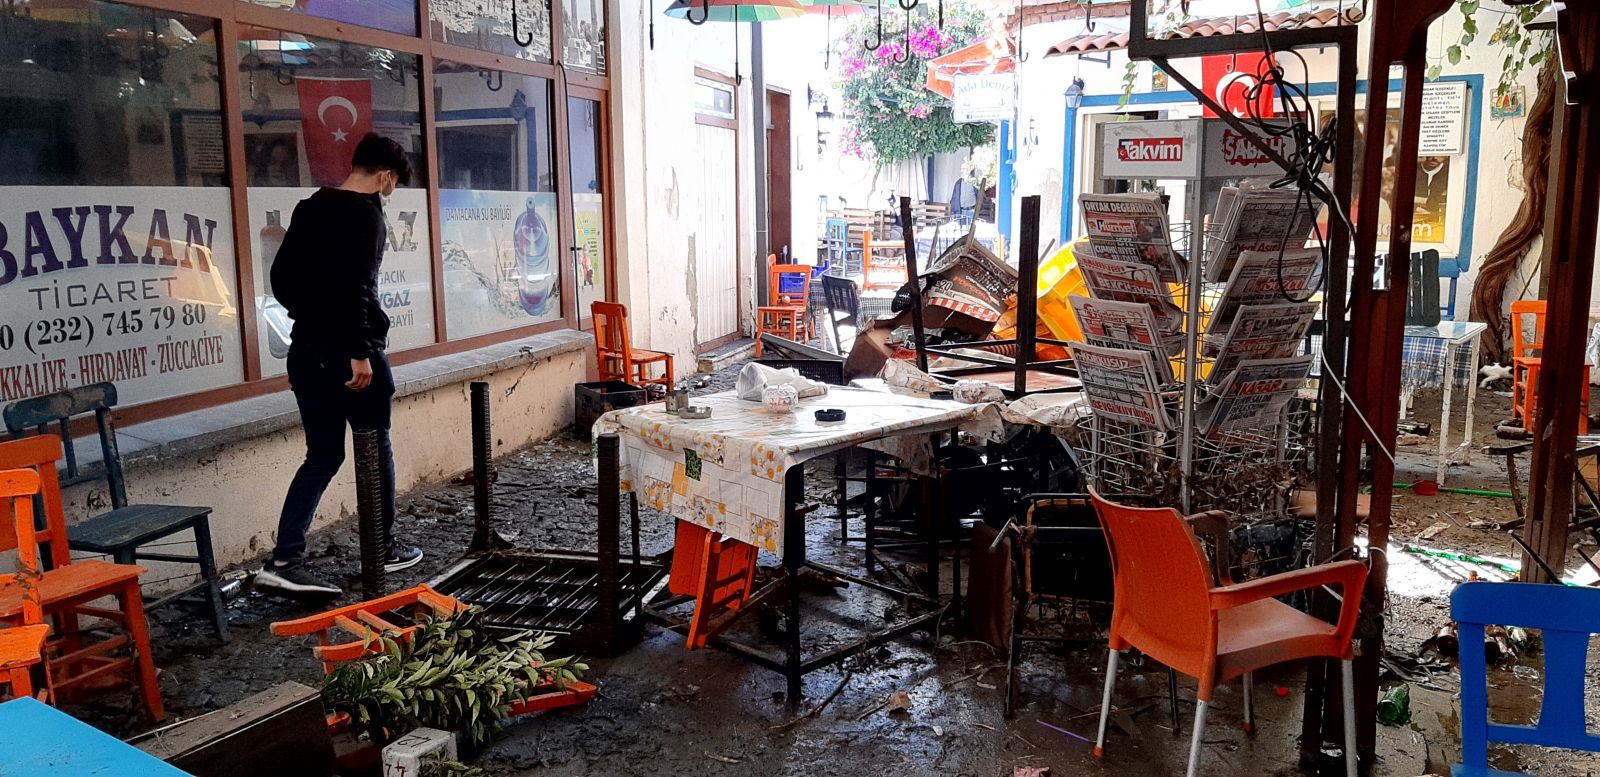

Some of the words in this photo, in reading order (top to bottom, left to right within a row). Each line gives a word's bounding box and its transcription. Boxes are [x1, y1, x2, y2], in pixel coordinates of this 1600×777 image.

[1121, 140, 1183, 161] Takvim
[446, 208, 480, 221] DAMACANA
[481, 208, 490, 220] SU
[28, 276, 178, 311] TİCARET
[24, 315, 94, 355] (232)
[102, 310, 144, 336] 745
[150, 306, 175, 330] 79
[182, 303, 206, 326] 80
[78, 346, 148, 384] HIRDAVAT
[157, 330, 224, 374] ZÜCCACİYE
